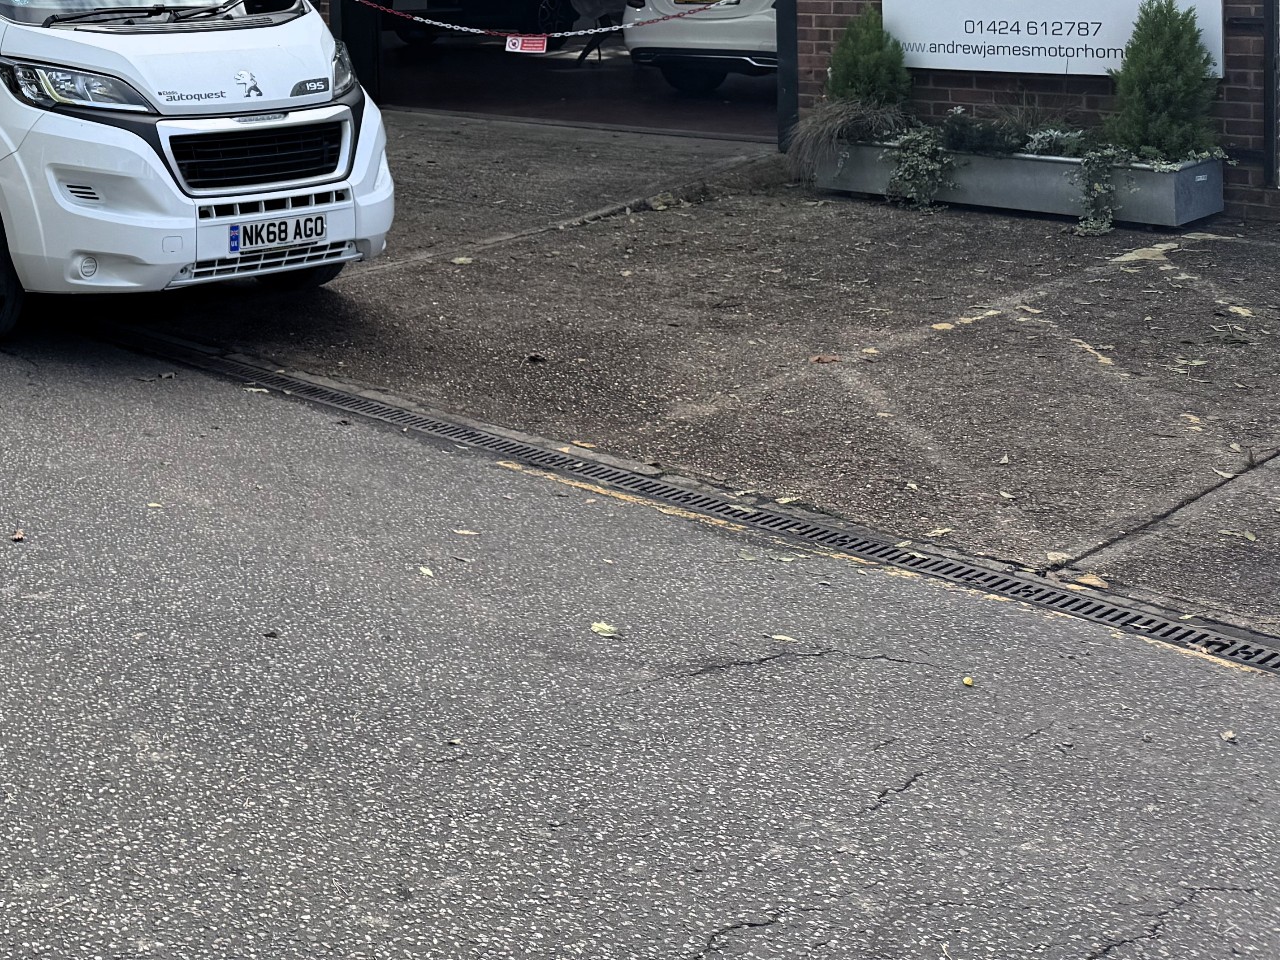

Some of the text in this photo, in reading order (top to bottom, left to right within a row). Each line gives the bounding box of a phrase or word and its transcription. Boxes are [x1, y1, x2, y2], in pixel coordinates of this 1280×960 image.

[964, 19, 1103, 37] 01424 612787
[901, 41, 1128, 59] ww.andrewjamesmotorhom
[306, 82, 325, 91] 195
[166, 90, 227, 102] autoquest
[242, 216, 324, 247] NK68 AGO
